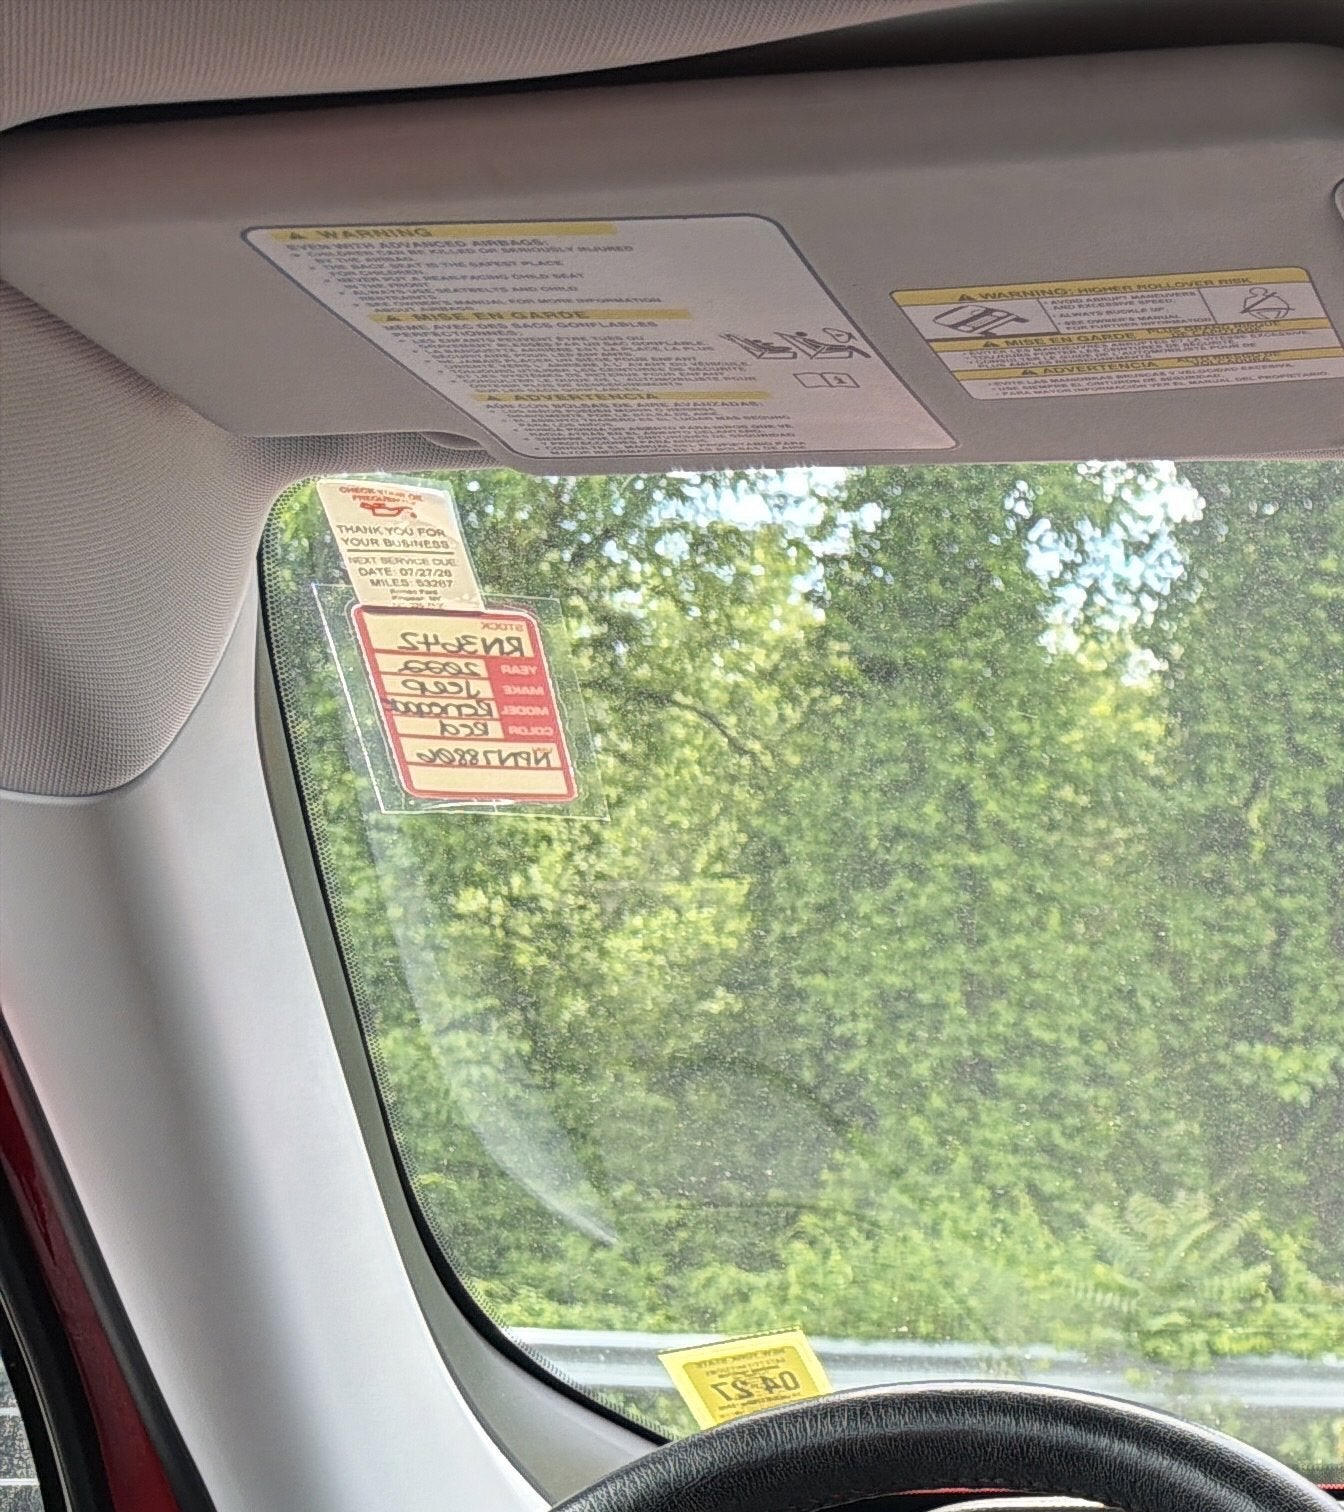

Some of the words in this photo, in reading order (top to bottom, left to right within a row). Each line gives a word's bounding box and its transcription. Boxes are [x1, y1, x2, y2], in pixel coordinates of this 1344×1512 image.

[316, 228, 433, 238] WARNING
[979, 288, 1075, 299] WARNING:
[1077, 285, 1133, 295] HIGHER
[1137, 280, 1214, 290] ROLLOVER
[1218, 277, 1252, 286] RISK
[511, 311, 590, 320] GARDE
[1005, 338, 1045, 347] MISE
[1051, 336, 1073, 344] EN
[1077, 332, 1137, 342] GARDE
[1043, 361, 1159, 374] ADVERTENCIA
[336, 525, 382, 534] THANK
[384, 526, 414, 536] YOU
[418, 527, 447, 538] FOR
[341, 537, 379, 547] YOUR
[383, 538, 450, 549] BUSINESS
[348, 556, 377, 565] NEXT
[381, 557, 429, 565] SERVICE
[432, 559, 457, 567] DUE
